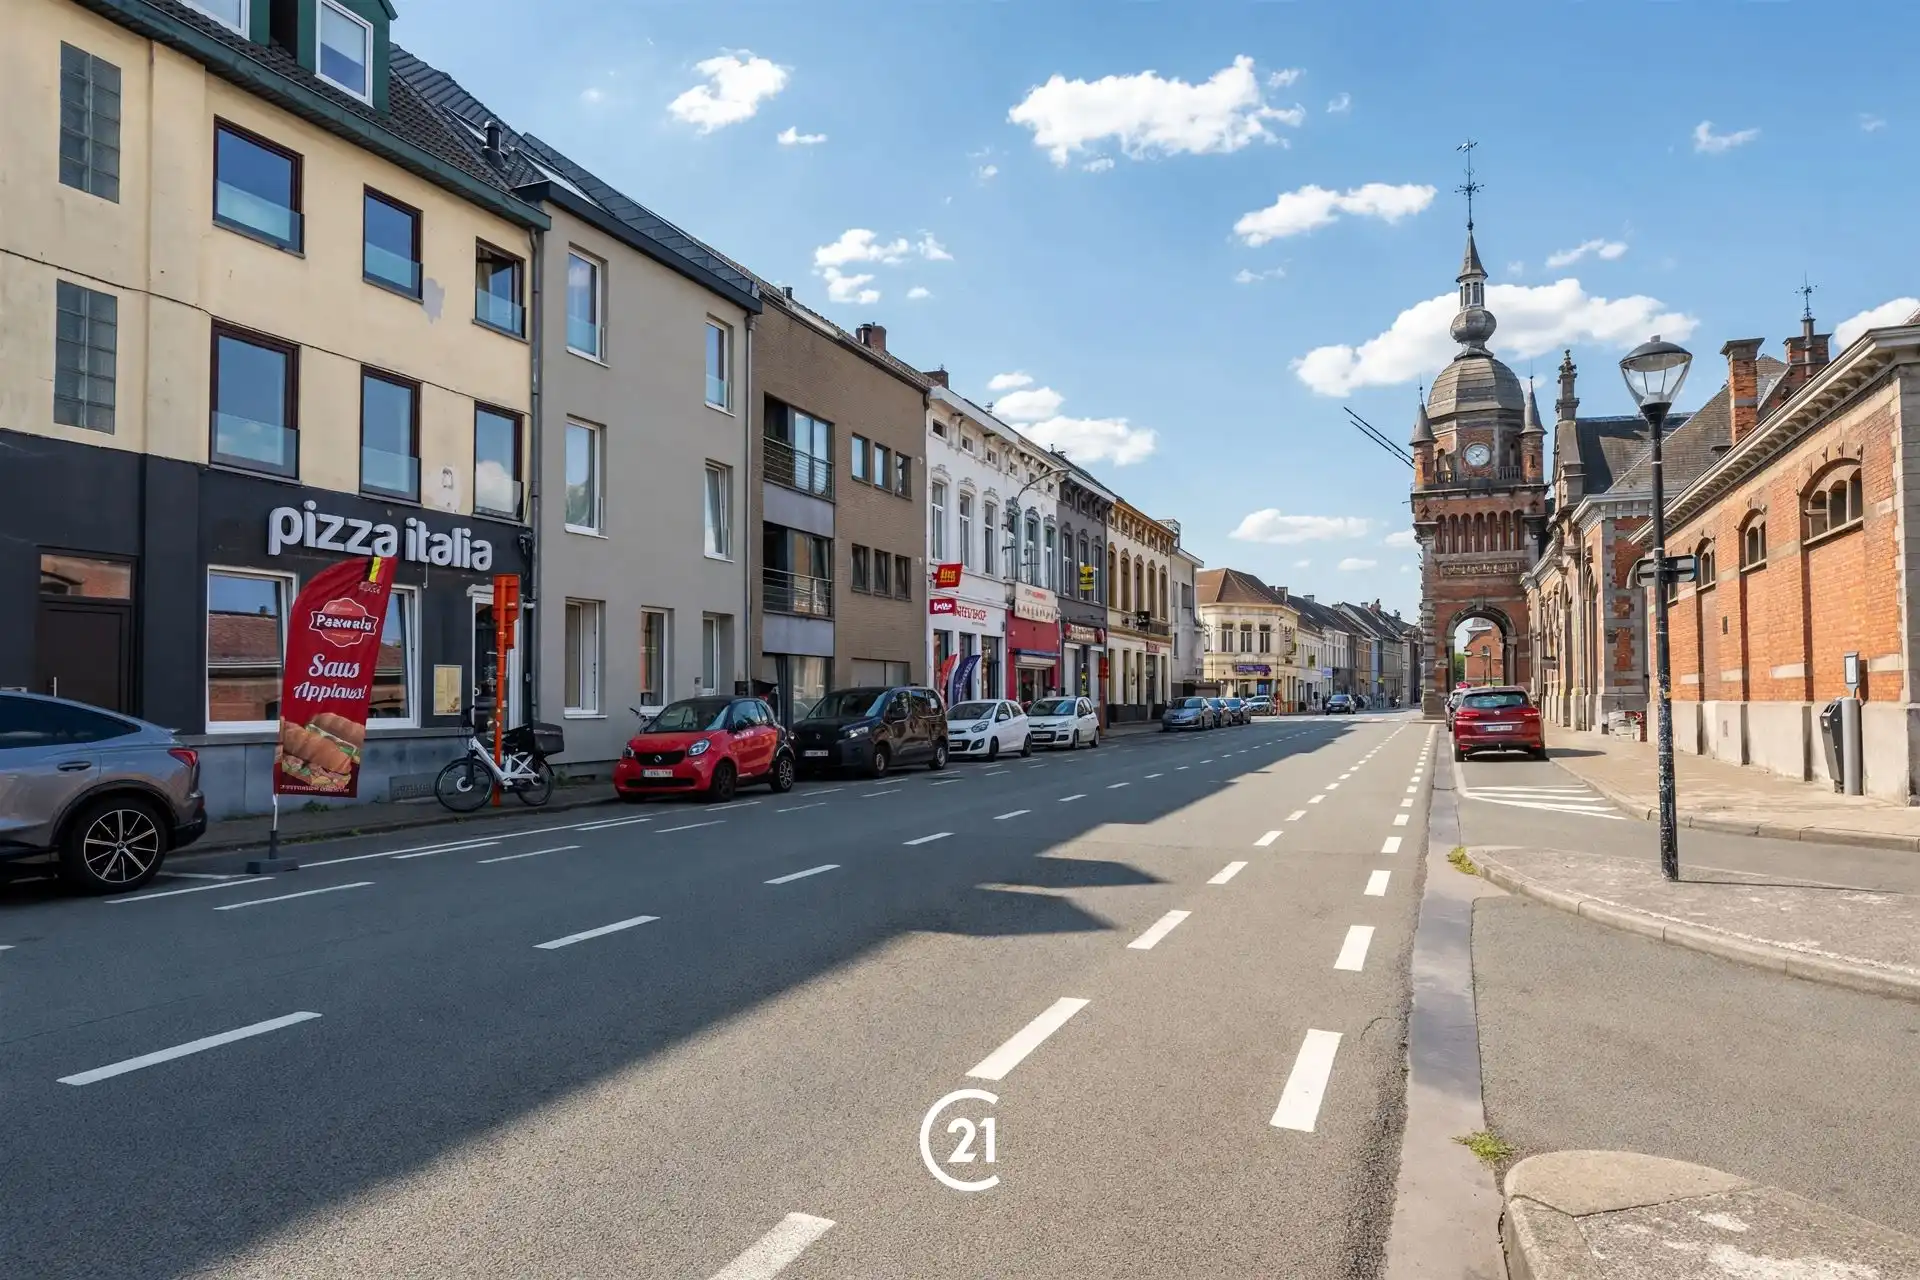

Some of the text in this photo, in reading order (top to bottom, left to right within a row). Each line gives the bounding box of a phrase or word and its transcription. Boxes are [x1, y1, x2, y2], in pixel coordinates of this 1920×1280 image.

[268, 500, 492, 572] pizza italia
[308, 653, 360, 678] Saus
